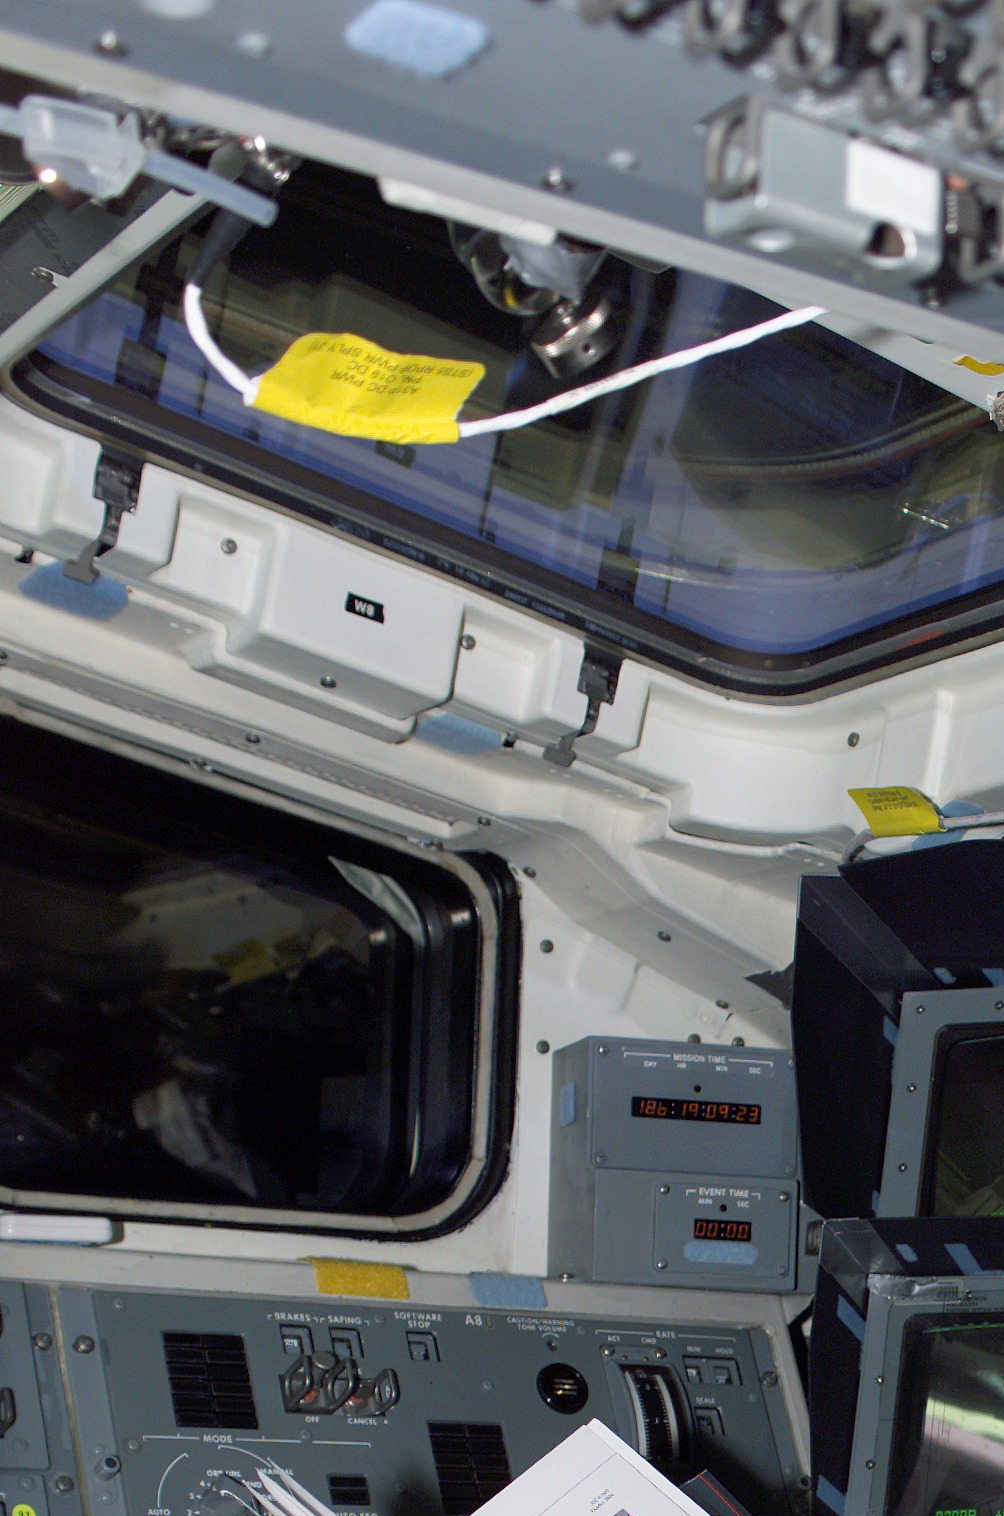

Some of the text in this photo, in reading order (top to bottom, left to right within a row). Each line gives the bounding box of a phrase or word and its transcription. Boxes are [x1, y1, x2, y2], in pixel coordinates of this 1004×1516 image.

[345, 360, 371, 376] DC
[329, 370, 365, 389] PWR
[673, 1053, 726, 1064] MISSION TIME
[748, 1067, 761, 1075] SEC
[699, 1187, 749, 1198] EVENT TIME
[697, 1197, 713, 1205] MIN
[736, 1200, 749, 1208] SEC
[695, 1220, 749, 1239] 00:00
[274, 1312, 311, 1323] BRAKES
[327, 1314, 362, 1325] SAFING
[394, 1311, 442, 1323] SOFTWARE
[407, 1320, 431, 1330] STOP
[536, 1323, 568, 1334] VOLUME
[607, 1334, 620, 1343] ACT
[655, 1330, 676, 1340] RATE
[304, 1415, 320, 1425] OFF
[347, 1416, 378, 1427] CANCEL
[203, 1434, 233, 1444] MODE
[148, 1508, 171, 1516] AUTO
